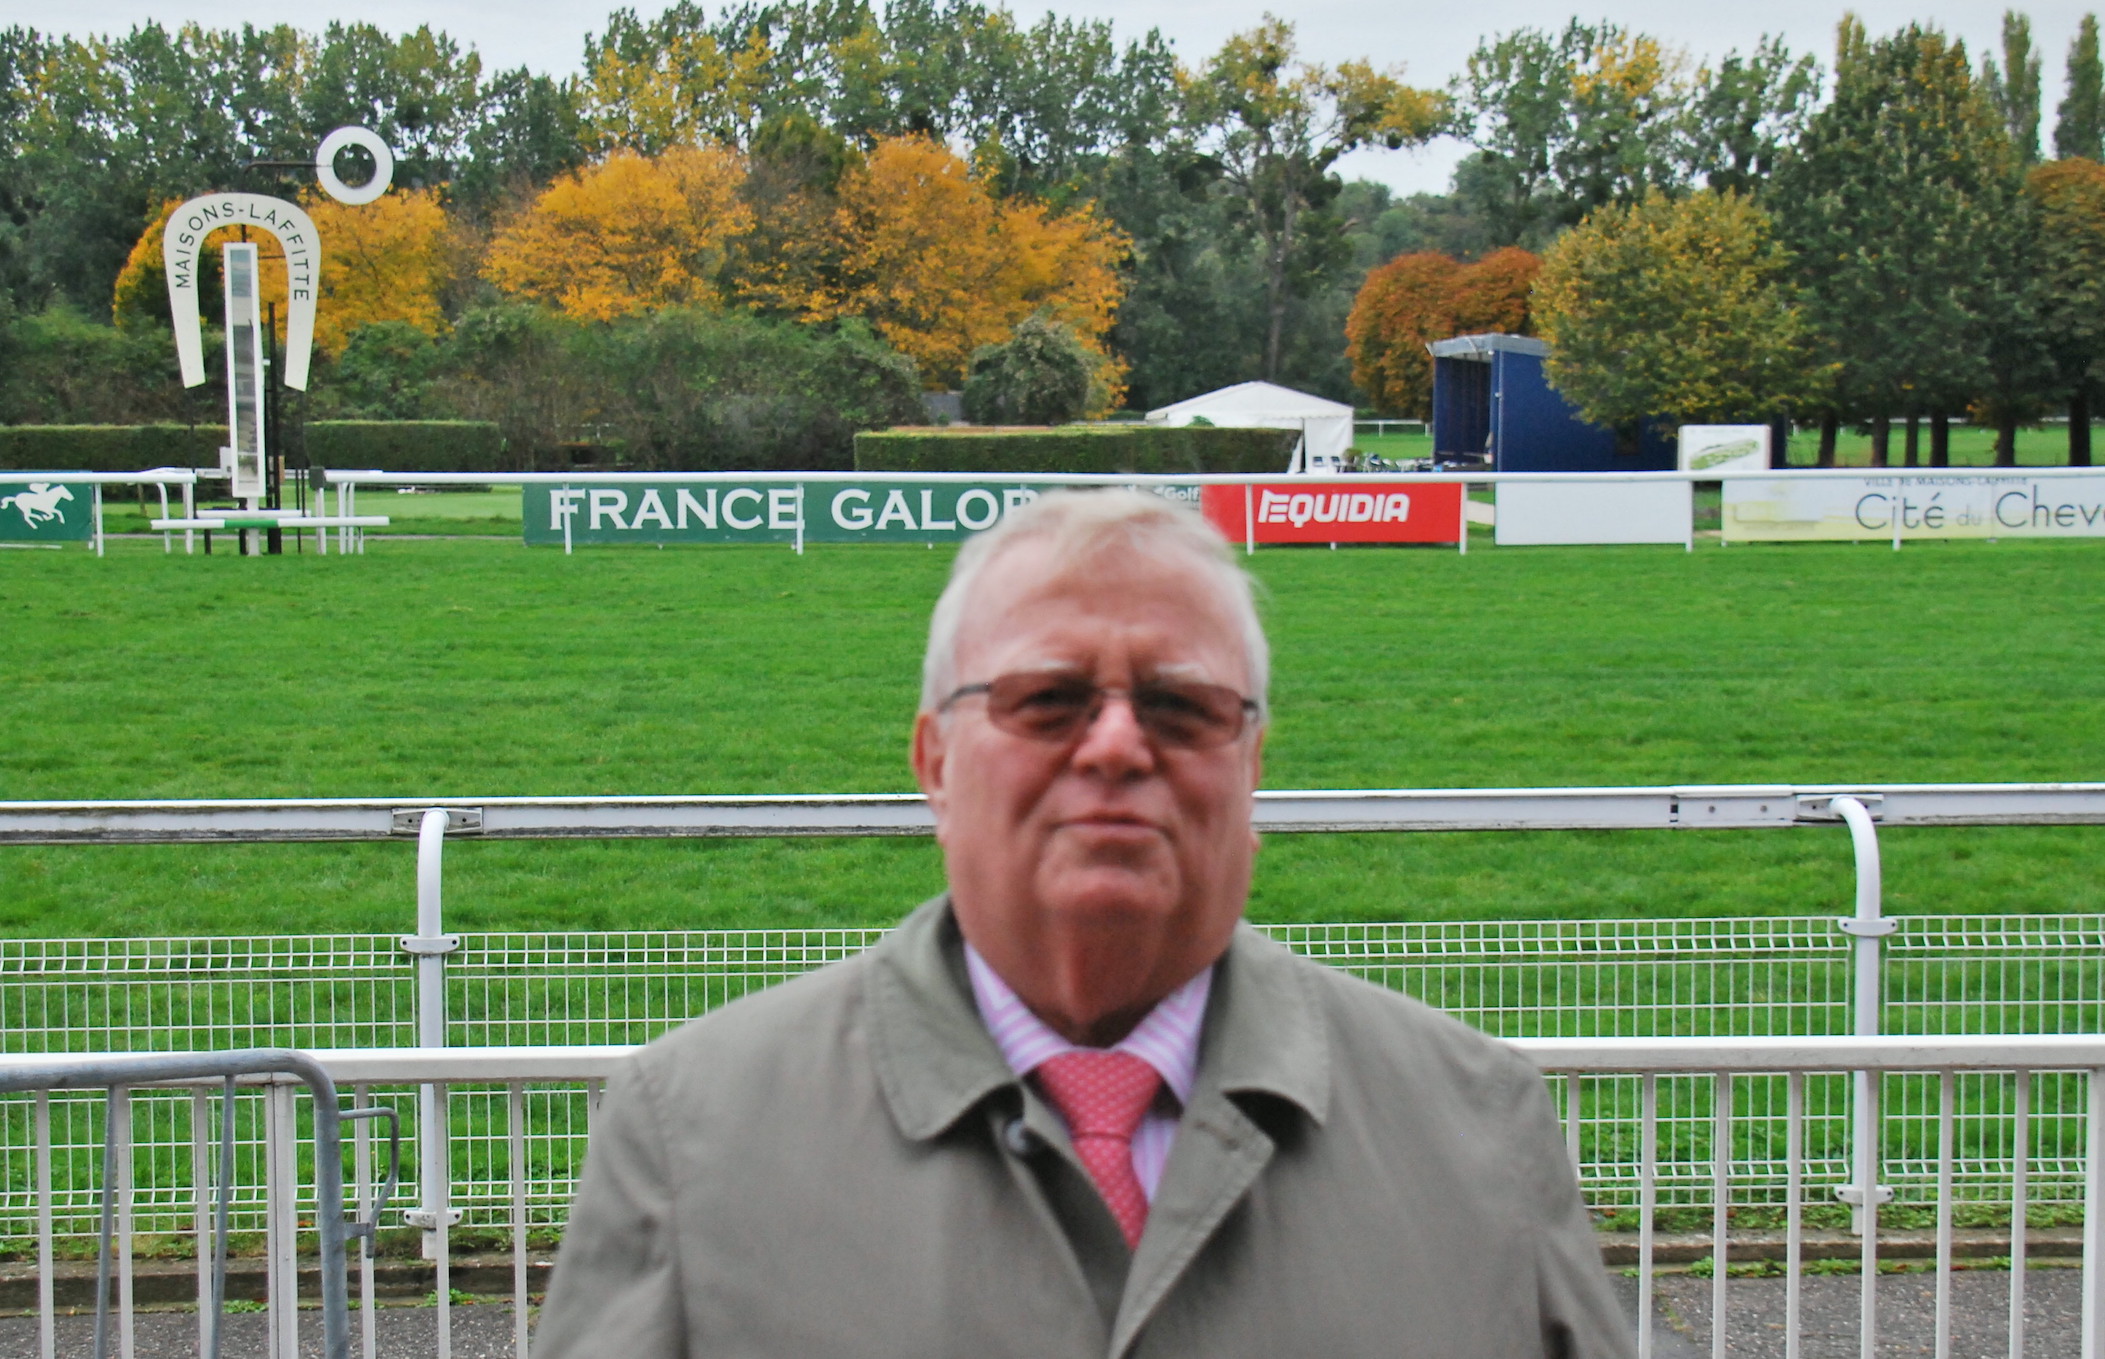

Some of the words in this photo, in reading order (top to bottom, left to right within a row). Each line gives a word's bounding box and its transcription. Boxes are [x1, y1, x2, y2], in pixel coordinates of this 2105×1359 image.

[174, 201, 310, 301] MAISONS-LAFFITTE
[549, 488, 806, 531] FRANCE
[1257, 488, 1411, 528] EQUIDIA
[1855, 491, 1945, 531] Cité
[1956, 503, 1983, 527] du
[1995, 484, 2105, 528] Chev
